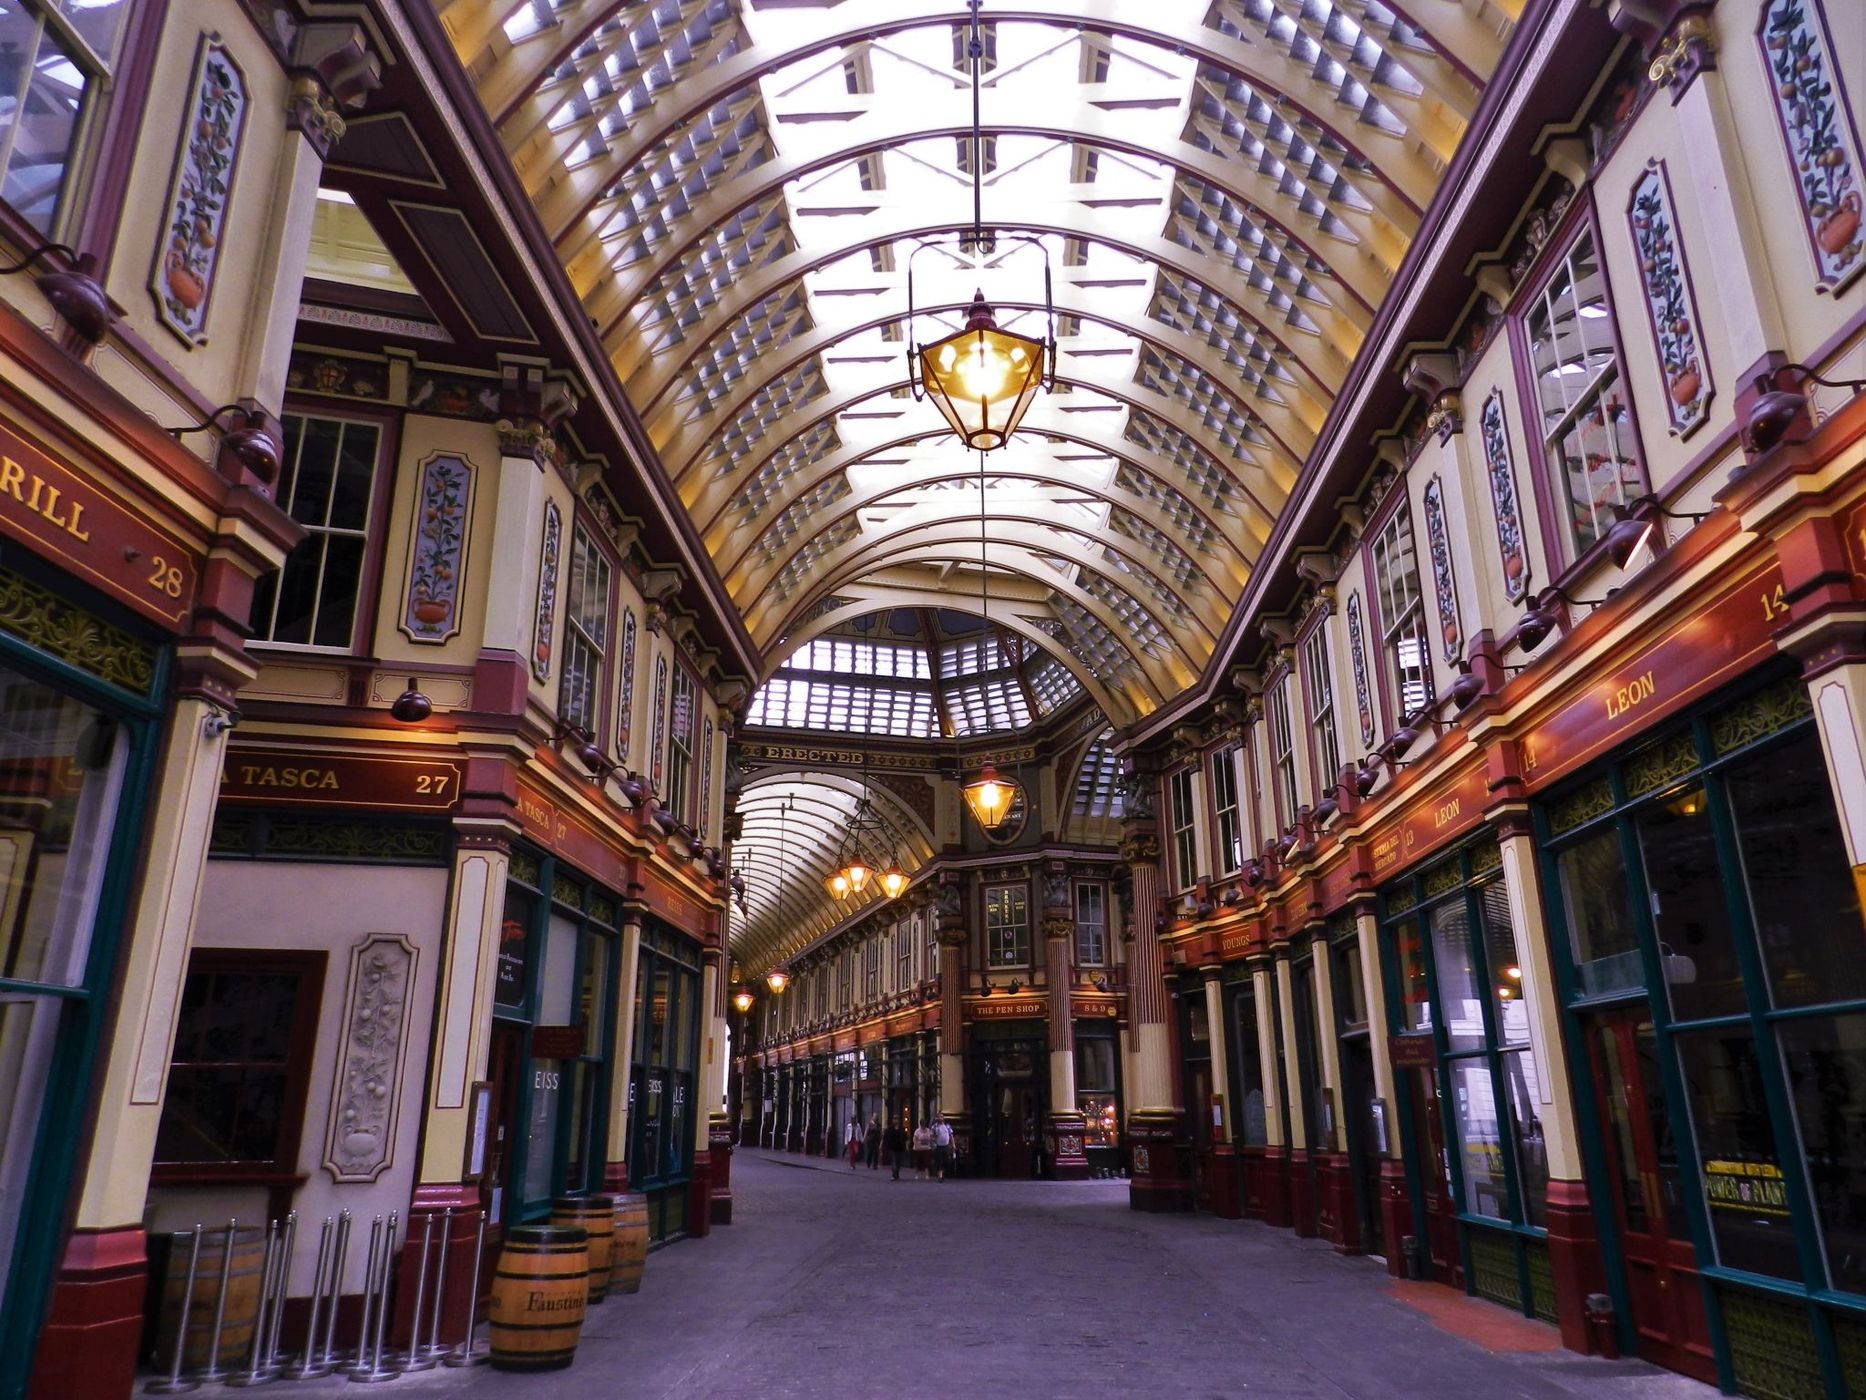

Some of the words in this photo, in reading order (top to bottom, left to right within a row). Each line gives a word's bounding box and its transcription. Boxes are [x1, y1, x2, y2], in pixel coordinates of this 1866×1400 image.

[148, 555, 183, 598] 28
[1605, 670, 1655, 720] LEON
[766, 746, 864, 764] ERECTED
[1524, 748, 1537, 773] 14
[241, 765, 340, 789] TASCA
[416, 775, 449, 794] 27
[524, 800, 549, 830] TASCA
[1434, 799, 1460, 829] LEON
[1222, 934, 1250, 951] YOUNGS
[977, 1006, 993, 1015] THE
[996, 1005, 1013, 1014] PEN
[1016, 1002, 1040, 1013] SHOP
